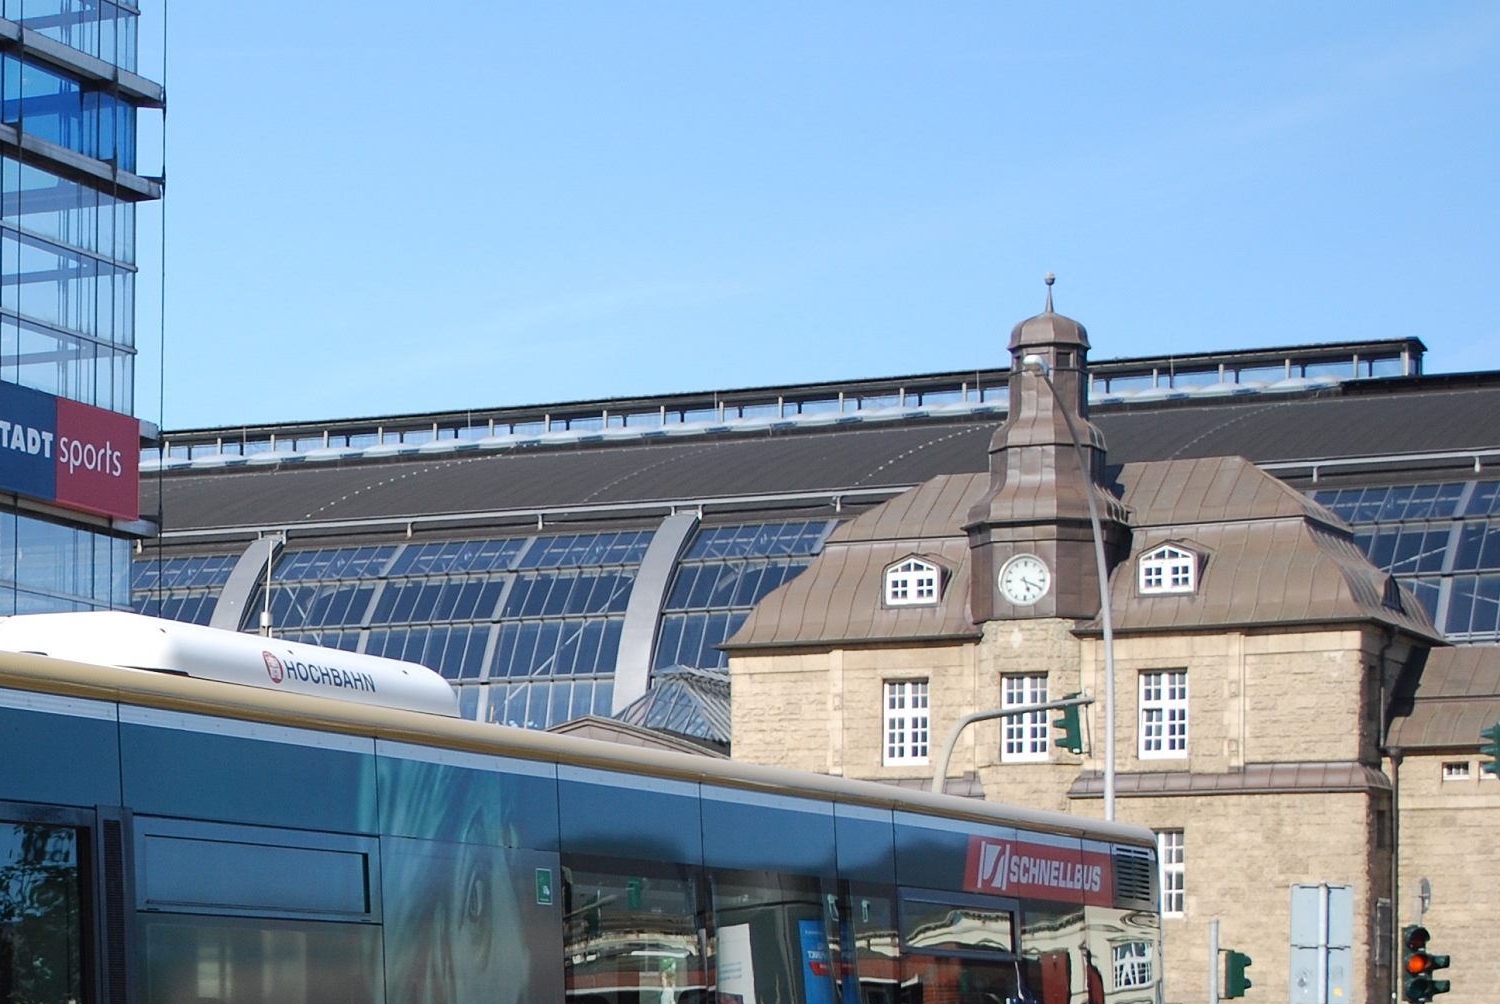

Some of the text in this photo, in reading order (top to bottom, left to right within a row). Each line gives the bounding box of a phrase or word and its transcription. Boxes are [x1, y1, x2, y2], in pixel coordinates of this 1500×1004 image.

[59, 437, 122, 477] sports
[282, 659, 376, 693] HOCHBAHN
[1010, 855, 1101, 892] SCHNELLBUS
